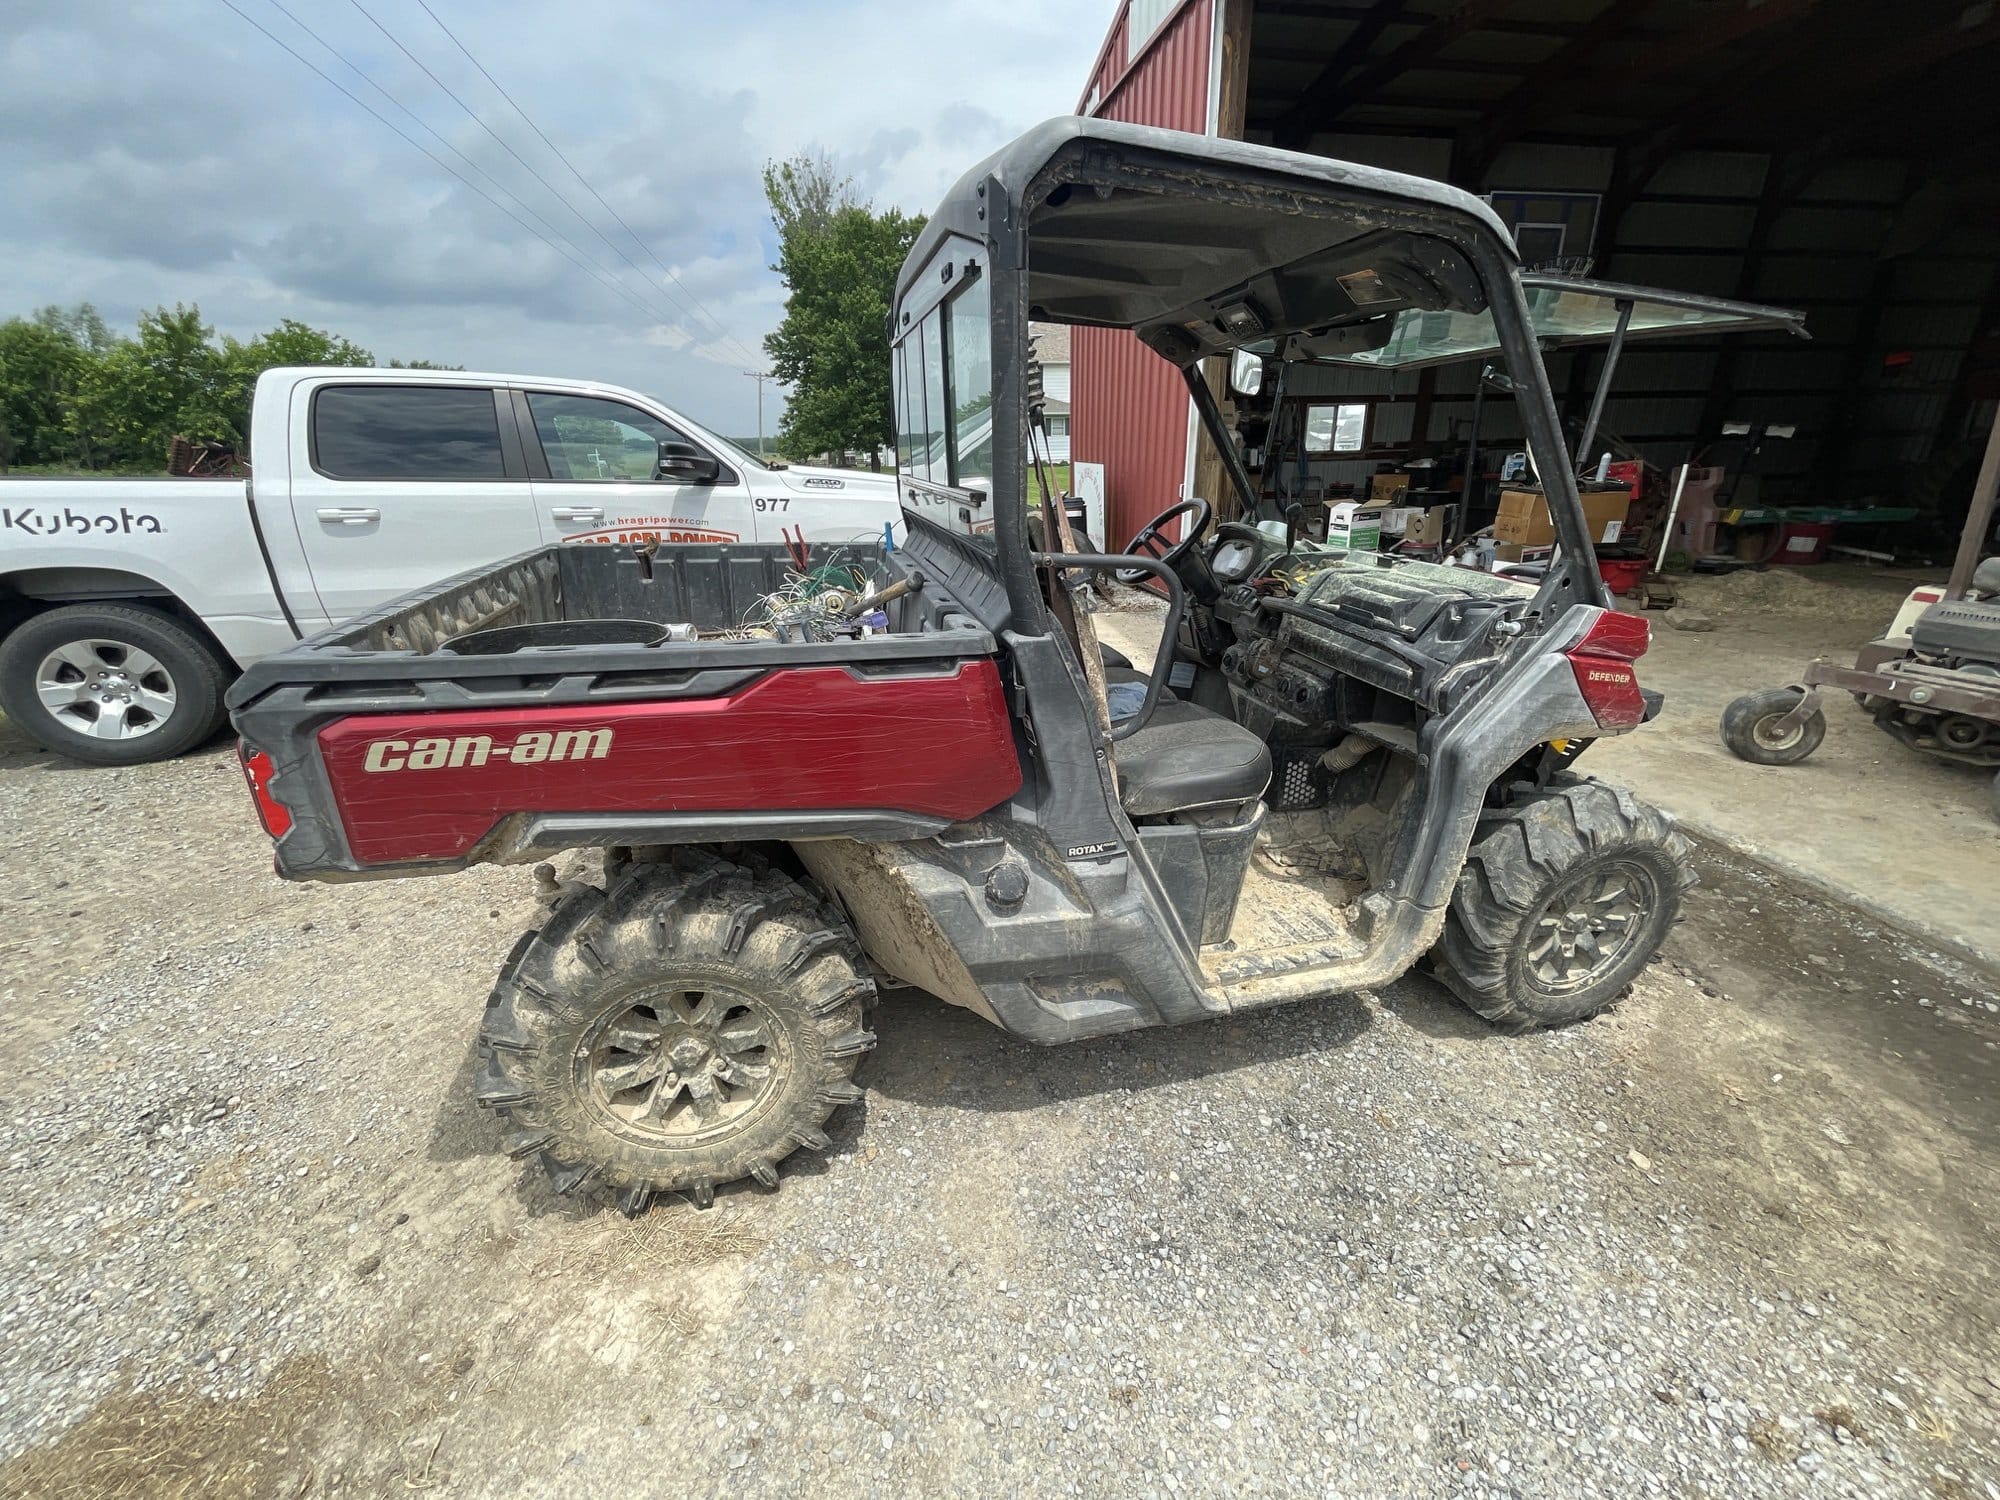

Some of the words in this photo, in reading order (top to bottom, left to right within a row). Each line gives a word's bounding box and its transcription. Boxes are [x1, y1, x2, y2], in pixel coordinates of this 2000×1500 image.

[755, 498, 790, 512] 977
[2, 507, 162, 535] Kubota
[591, 515, 709, 529] www.hragripower.com
[1589, 671, 1631, 683] DEFENDER
[364, 728, 614, 773] can-am
[1068, 844, 1104, 856] ROTAX
